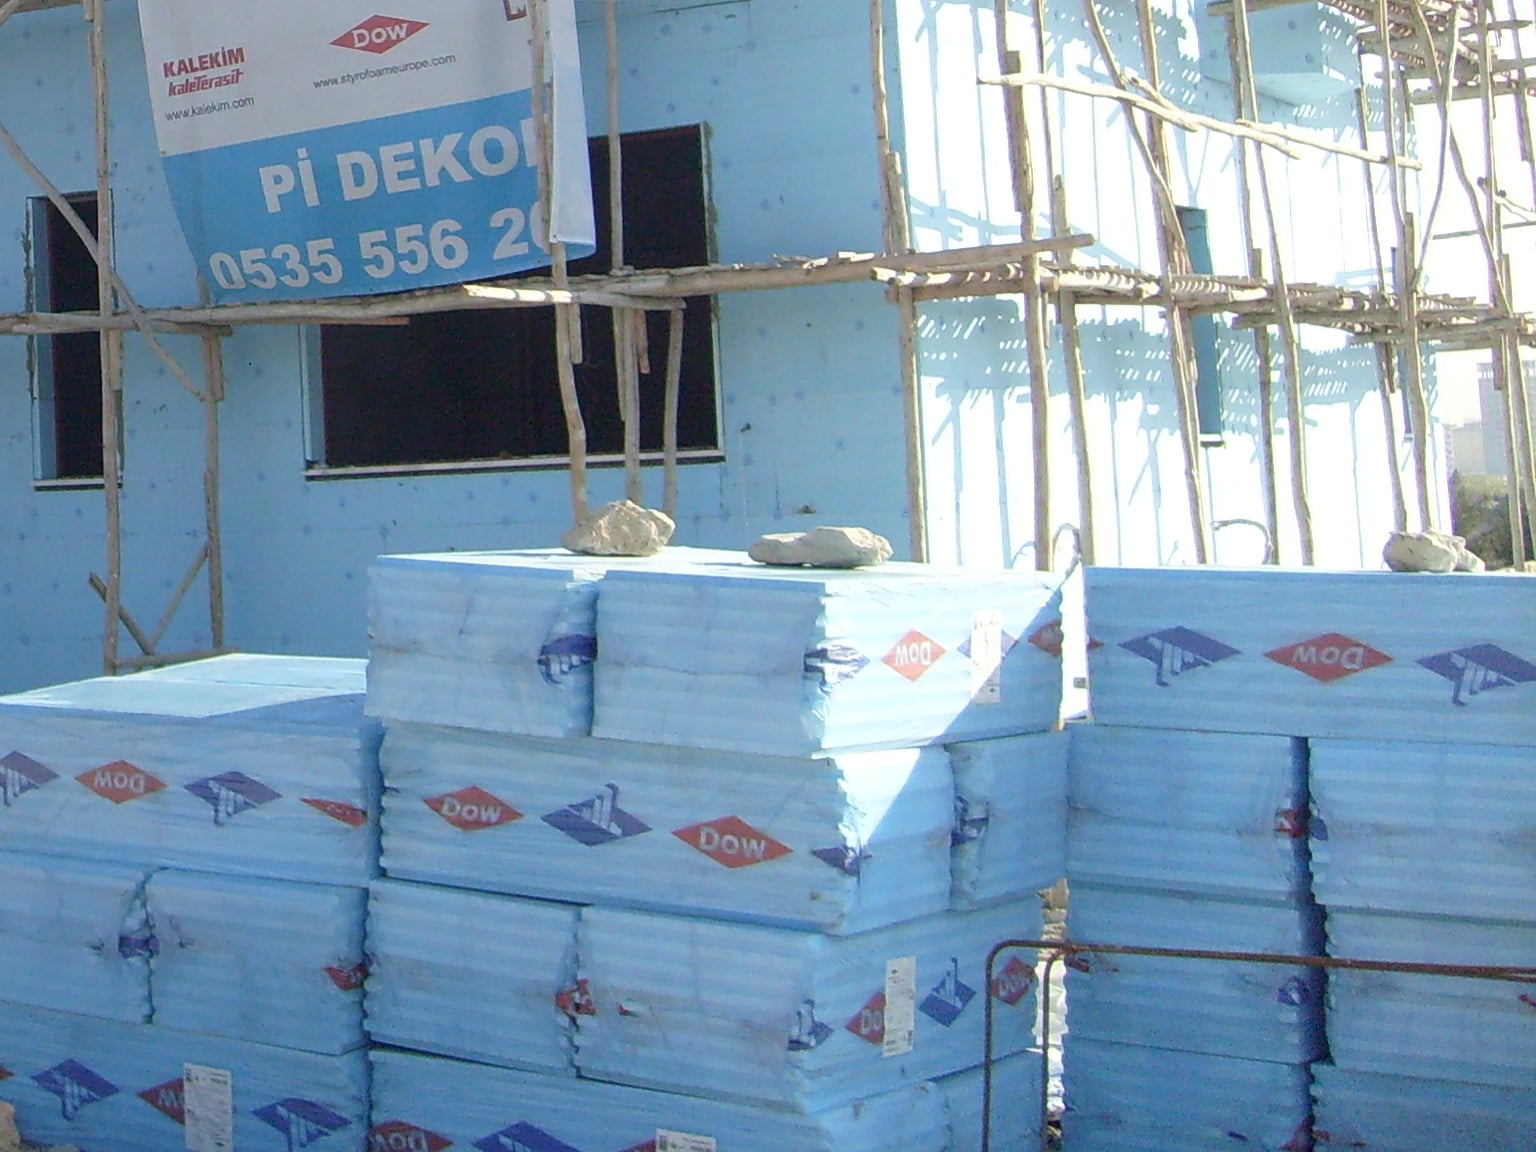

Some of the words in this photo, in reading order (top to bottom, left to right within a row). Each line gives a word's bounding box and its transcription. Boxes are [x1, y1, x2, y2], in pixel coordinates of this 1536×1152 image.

[313, 52, 456, 89] www.styrofoameurope.com
[165, 96, 255, 122] www.kalekim.com
[209, 237, 344, 291] 0535
[359, 218, 469, 279] 556
